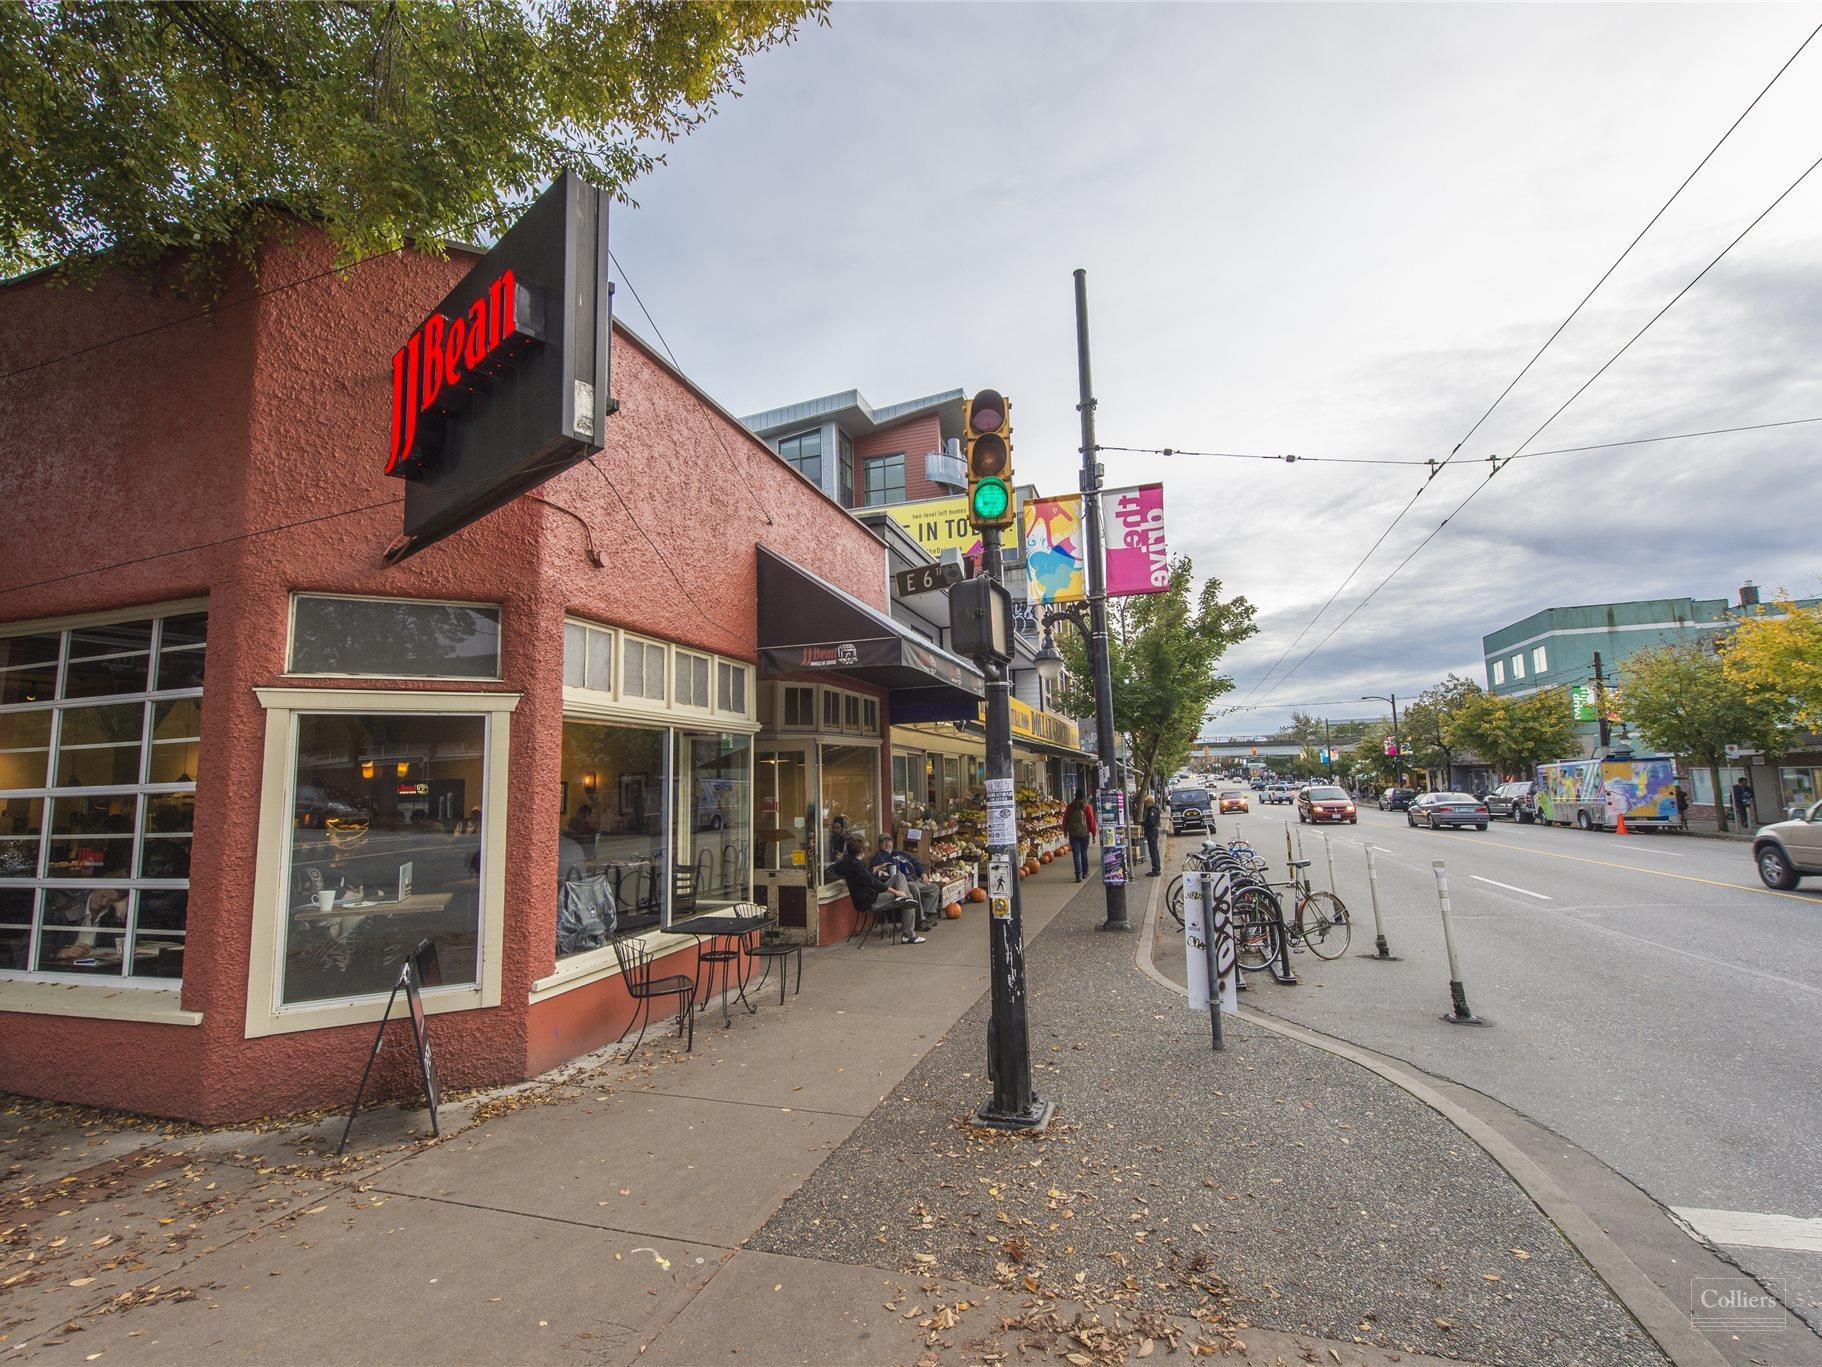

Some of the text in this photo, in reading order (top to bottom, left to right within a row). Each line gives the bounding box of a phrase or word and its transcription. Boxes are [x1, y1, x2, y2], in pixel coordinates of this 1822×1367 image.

[938, 509, 948, 517] loft
[948, 508, 967, 516] homes
[918, 522, 938, 542] IN
[906, 574, 915, 592] E
